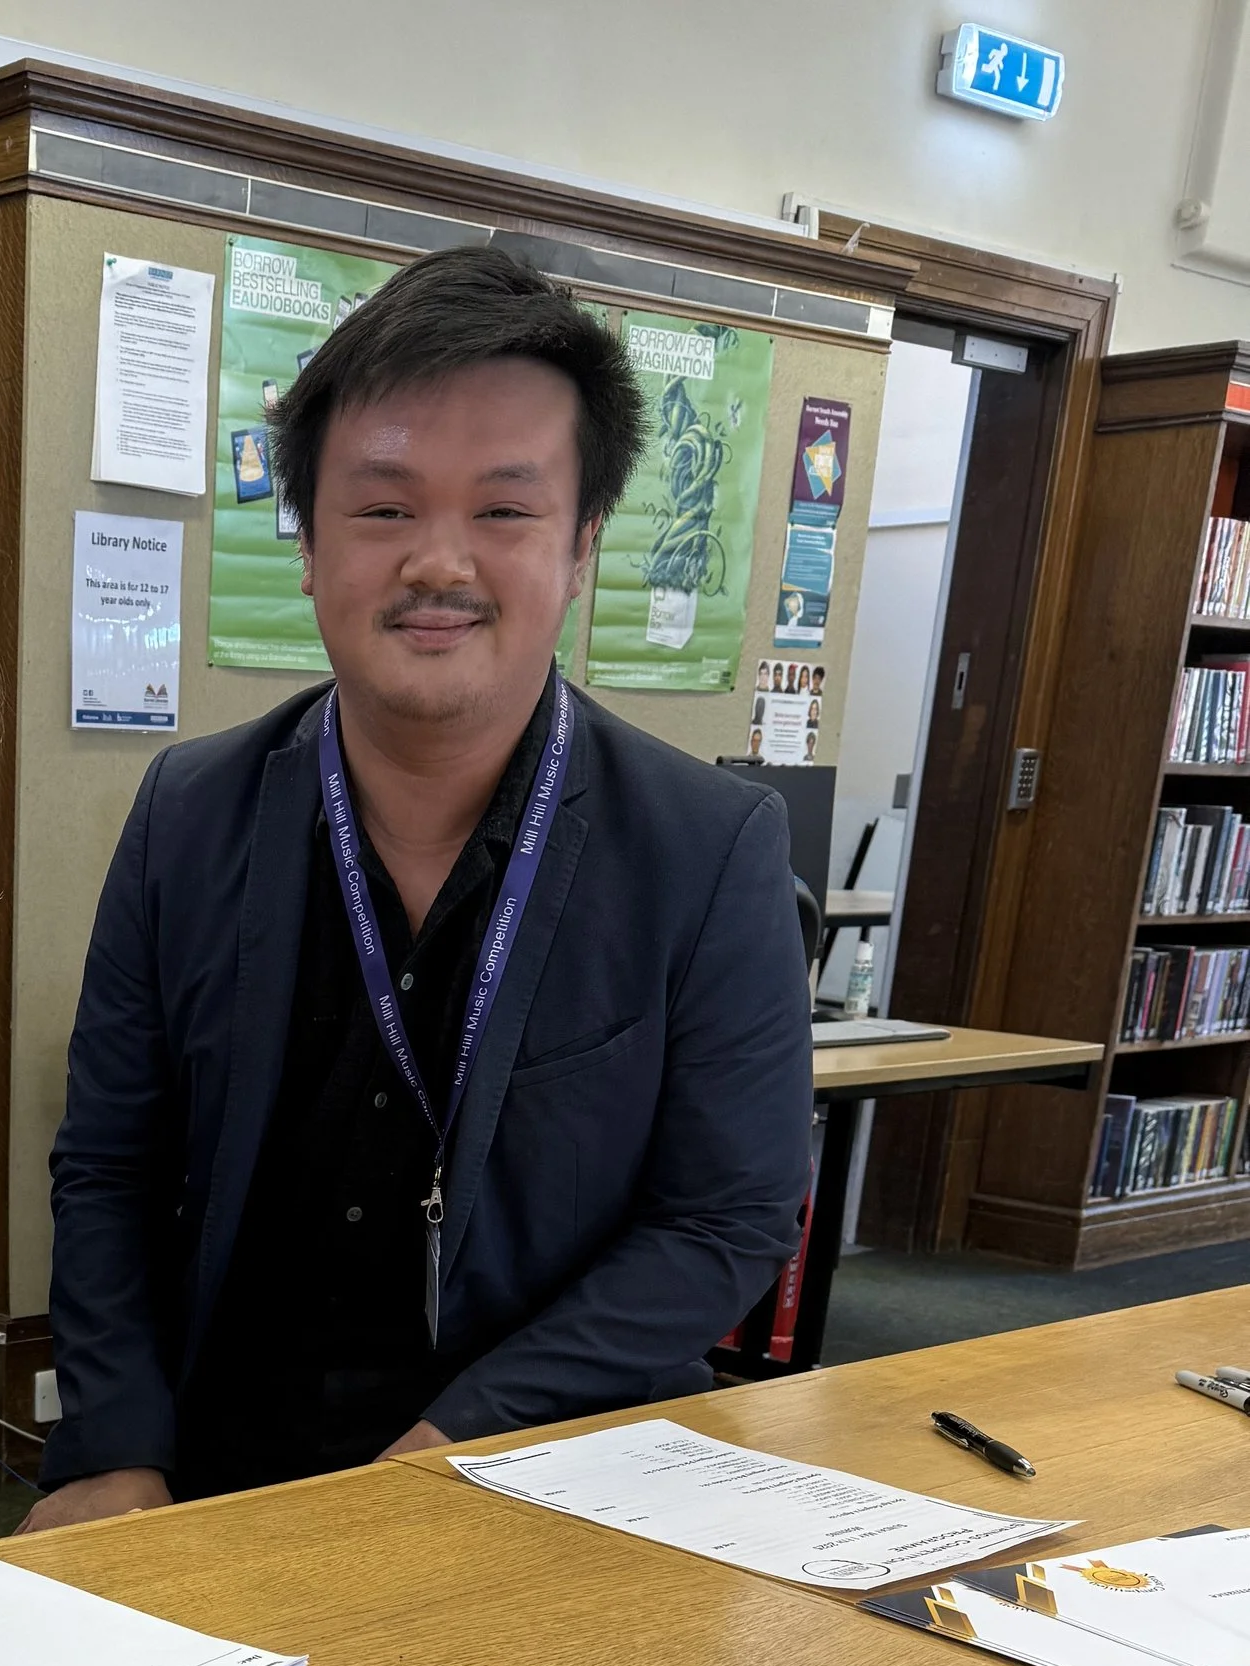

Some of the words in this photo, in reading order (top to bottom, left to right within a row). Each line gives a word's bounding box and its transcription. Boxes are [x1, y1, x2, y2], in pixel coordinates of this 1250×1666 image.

[234, 251, 295, 276] BORROW
[233, 271, 319, 300] BESTSELLING
[232, 289, 330, 320] EAUDIOBOOKS
[630, 328, 686, 353] BORROW
[687, 338, 712, 357] FOR
[91, 532, 130, 551] Library
[132, 536, 167, 552] Notice
[86, 578, 101, 588] This
[102, 581, 119, 590] area
[120, 581, 126, 591] is
[127, 582, 138, 592] for
[140, 583, 149, 593] 12
[150, 584, 159, 593] to
[160, 585, 169, 594] 17
[100, 596, 117, 606] year
[118, 596, 134, 606] olds
[135, 598, 151, 609] only
[552, 684, 568, 755] Competition
[328, 773, 342, 799] Mill
[540, 758, 560, 800] Music
[333, 800, 348, 825] Hill
[529, 802, 547, 827] Hill
[338, 825, 356, 869] Music
[520, 830, 539, 855] Mill
[347, 870, 375, 956] Competition
[479, 897, 517, 984] Competition
[379, 994, 394, 1021] Mill
[466, 987, 488, 1030] Music
[386, 1022, 402, 1047] Hill
[460, 1034, 474, 1058] Hill
[396, 1047, 418, 1088] Music
[454, 1061, 466, 1086] Mill
[888, 1528, 973, 1552] PROGRAMME
